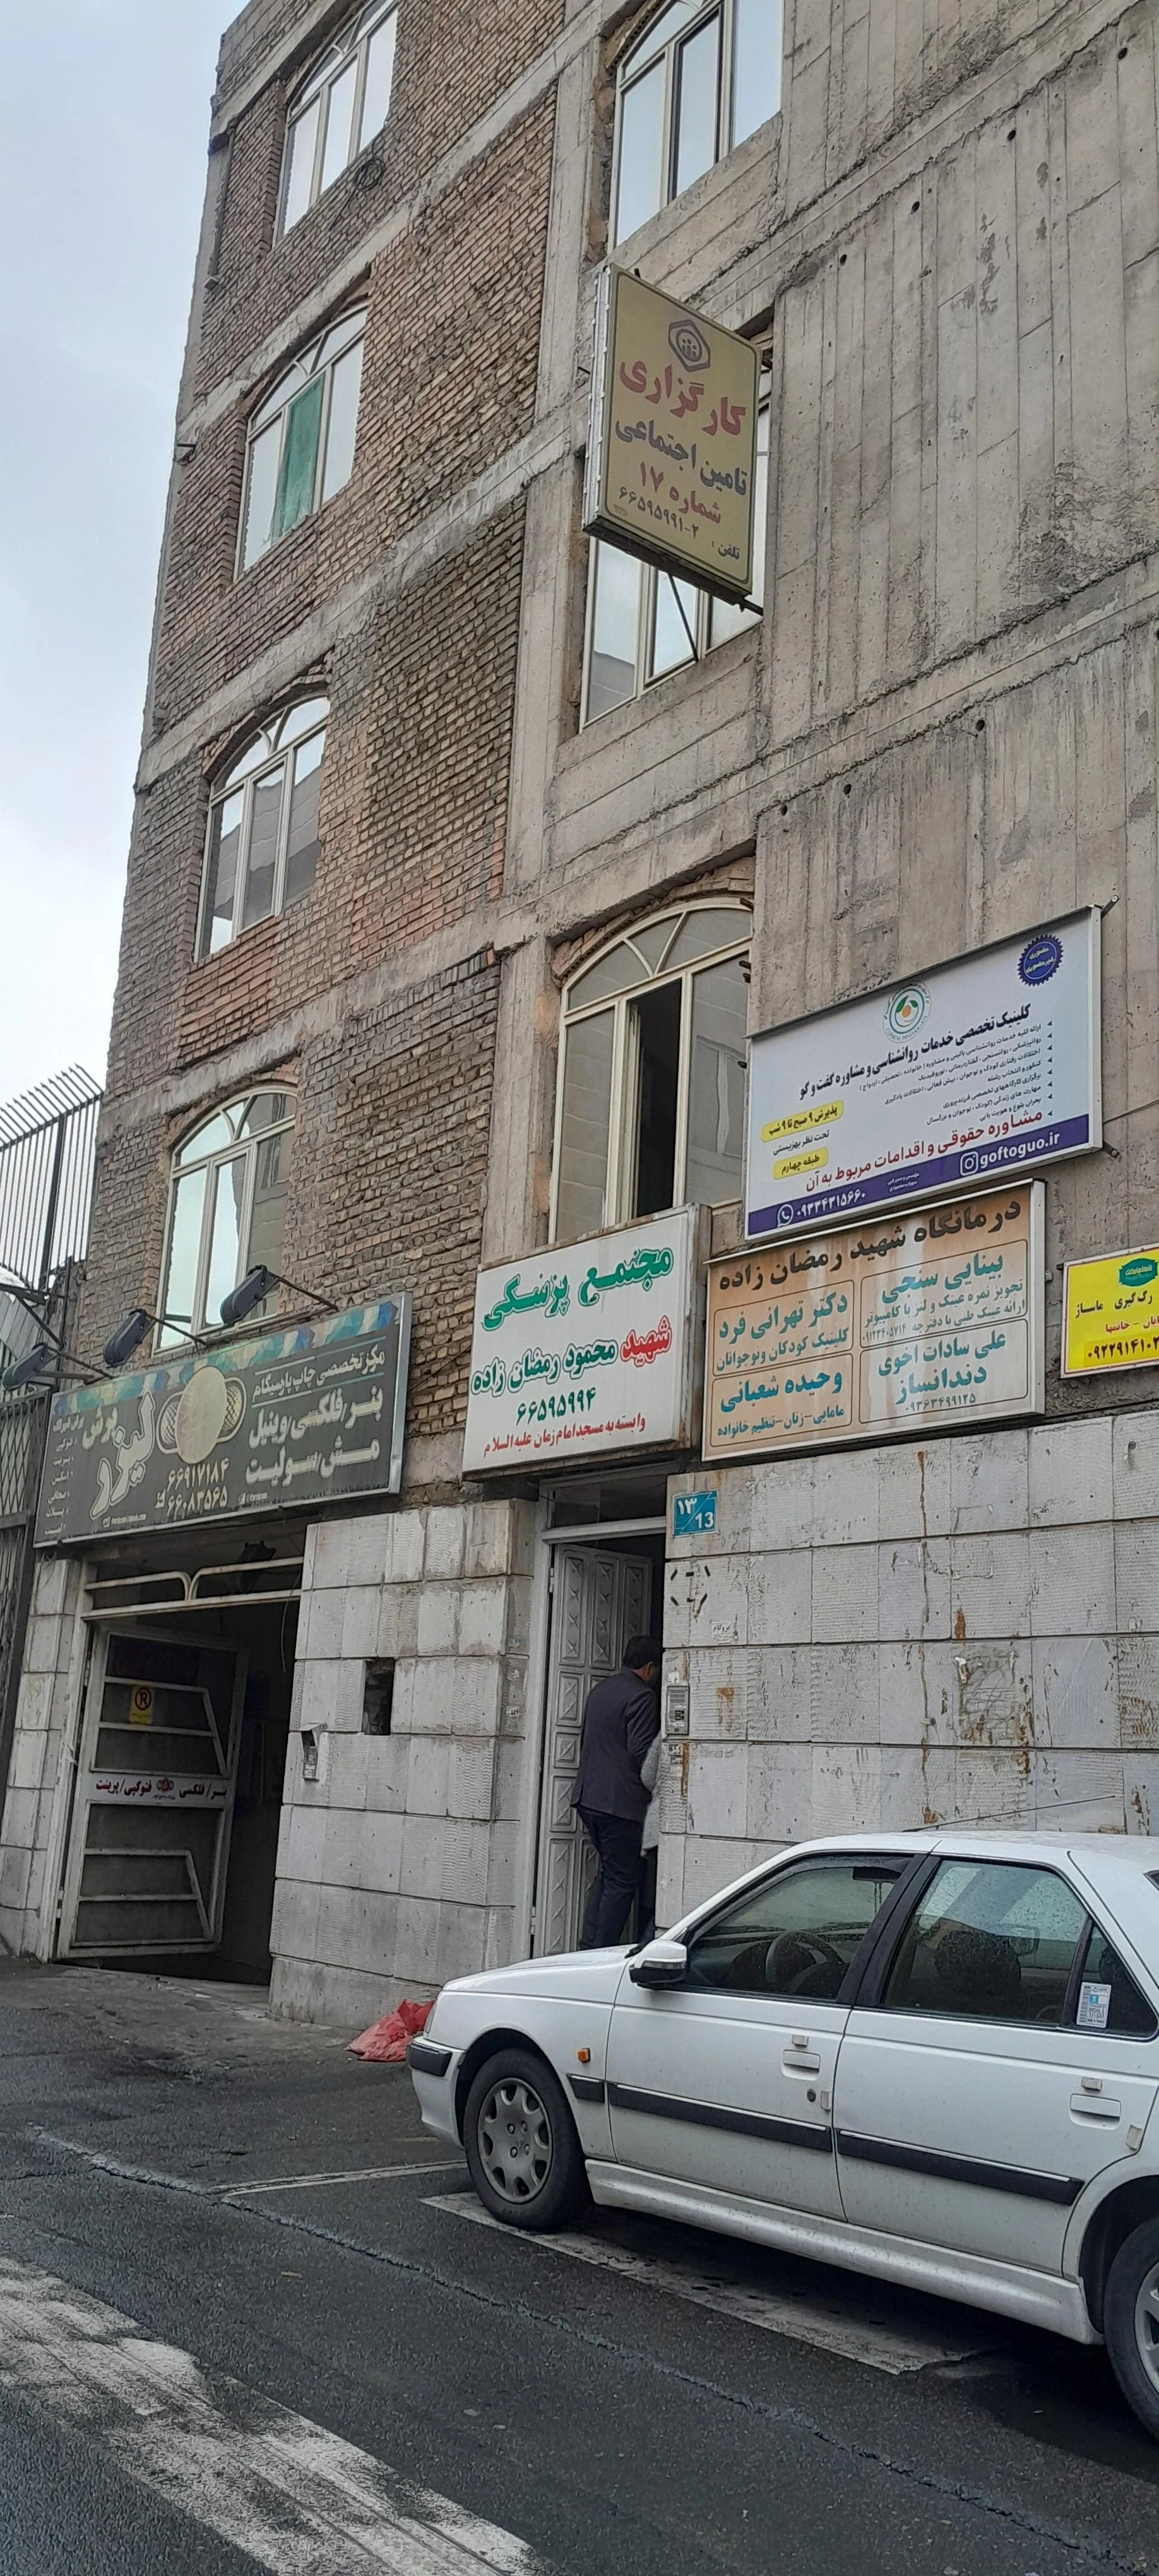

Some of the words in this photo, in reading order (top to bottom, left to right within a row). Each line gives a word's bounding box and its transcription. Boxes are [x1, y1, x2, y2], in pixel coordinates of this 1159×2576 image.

[615, 420, 696, 472] اجتماعی
[639, 461, 664, 493] ۱۷
[700, 461, 747, 496] تامین
[619, 486, 699, 539] ۶۶۵۹۵۹۹۱-۲
[669, 486, 721, 524] شماره
[996, 1003, 1031, 1028] کلینیک
[955, 1017, 995, 1046] تخصصی
[996, 1033, 1016, 1044] خدمات
[920, 1030, 953, 1054] خدمات
[966, 1042, 996, 1055] روانشناسی
[872, 1046, 918, 1075] روانشناسی
[926, 1058, 945, 1069] مشاوره
[999, 1056, 1016, 1068] رفتاری
[1018, 1048, 1040, 1061] اختلالات
[835, 1064, 865, 1087] مشاوره
[866, 1065, 872, 1078] و
[984, 1061, 999, 1071] کودک
[1002, 1066, 1021, 1078] انتخاب
[1026, 1060, 1041, 1071] کنکور
[987, 1073, 1001, 1082] رشته
[1022, 1072, 1041, 1084] برگزاری
[884, 1093, 903, 1105] یادگیری
[971, 1087, 994, 1100] تخصصی
[1023, 1085, 1041, 1095] مهارت
[994, 1095, 1009, 1106] زندگی
[1013, 1101, 1023, 1112] بلوغ
[1026, 1097, 1041, 1107] بحران
[809, 1112, 812, 1122] ۹
[814, 1105, 838, 1123] پذیرش
[992, 1107, 1007, 1117] هویت
[769, 1123, 781, 1136] شب
[782, 1120, 786, 1130] ۹
[788, 1119, 792, 1128] تا
[793, 1117, 807, 1129] صبح
[988, 1110, 1043, 1138] مشاوره
[802, 1135, 812, 1147] نظر
[814, 1130, 830, 1141] تحت
[937, 1126, 985, 1154] حقوقی
[773, 1140, 801, 1156] بهزیستی
[874, 1140, 924, 1169] اقدامات
[927, 1145, 934, 1159] و
[979, 1131, 1061, 1169] goftoguo.ir
[782, 1162, 801, 1175] چهارم
[803, 1154, 819, 1166] طبقه
[805, 1170, 820, 1192] آن
[821, 1173, 832, 1187] به
[835, 1160, 871, 1182] مربوط
[850, 1226, 905, 1261] شهید
[720, 1263, 763, 1291] زاده
[770, 1250, 842, 1284] رمضان
[945, 1252, 1003, 1290] بینایی
[578, 1248, 674, 1307] مجتمع
[882, 1270, 938, 1304] سنجی
[968, 1286, 989, 1305] نمره
[994, 1279, 1023, 1301] تجویز
[1138, 1290, 1152, 1304] رگ
[482, 1273, 570, 1332] پزشکی
[809, 1292, 847, 1327] دکتر
[904, 1303, 910, 1317] با
[915, 1299, 926, 1317] لنز
[930, 1302, 935, 1314] و
[939, 1294, 964, 1308] عینک
[1004, 1299, 1025, 1314] ارائه
[1115, 1292, 1136, 1309] گیری
[751, 1300, 803, 1339] تهرانی
[865, 1305, 901, 1328] کامپیوتر
[946, 1314, 951, 1325] با
[954, 1311, 973, 1326] طبی
[977, 1306, 1001, 1318] عینک
[720, 1311, 746, 1344] فرد
[912, 1319, 942, 1333] دفترچه
[621, 1315, 672, 1368] شهید
[769, 1335, 808, 1361] کودکان
[812, 1327, 848, 1349] کلینیک
[975, 1330, 1006, 1359] علی
[362, 1344, 384, 1374] مرکز
[562, 1339, 619, 1380] محمود
[924, 1337, 970, 1362] سادات
[317, 1352, 364, 1386] تخصصی
[508, 1348, 561, 1393] رمضان
[878, 1345, 918, 1376] اخوی
[293, 1366, 316, 1392] چاپ
[472, 1357, 505, 1397] زاده
[785, 1372, 842, 1396] وحیده
[895, 1364, 987, 1405] دندانساز
[720, 1375, 779, 1412] شعبانی
[516, 1386, 596, 1426] ۶۶۵۹۵۹۹۴
[576, 1422, 603, 1441] مسجد
[605, 1419, 613, 1436] به
[615, 1412, 645, 1433] وابسته
[718, 1421, 749, 1439] خانواده
[514, 1431, 531, 1451] علیه
[534, 1428, 555, 1448] زمان
[556, 1423, 576, 1445] امام
[90, 1390, 155, 1520] لیزر
[484, 1433, 513, 1458] السلام
[167, 1458, 229, 1493] ۶۶۹۱۷۱۸۴
[677, 1496, 698, 1515] ۱۳
[695, 1512, 715, 1530] 13
